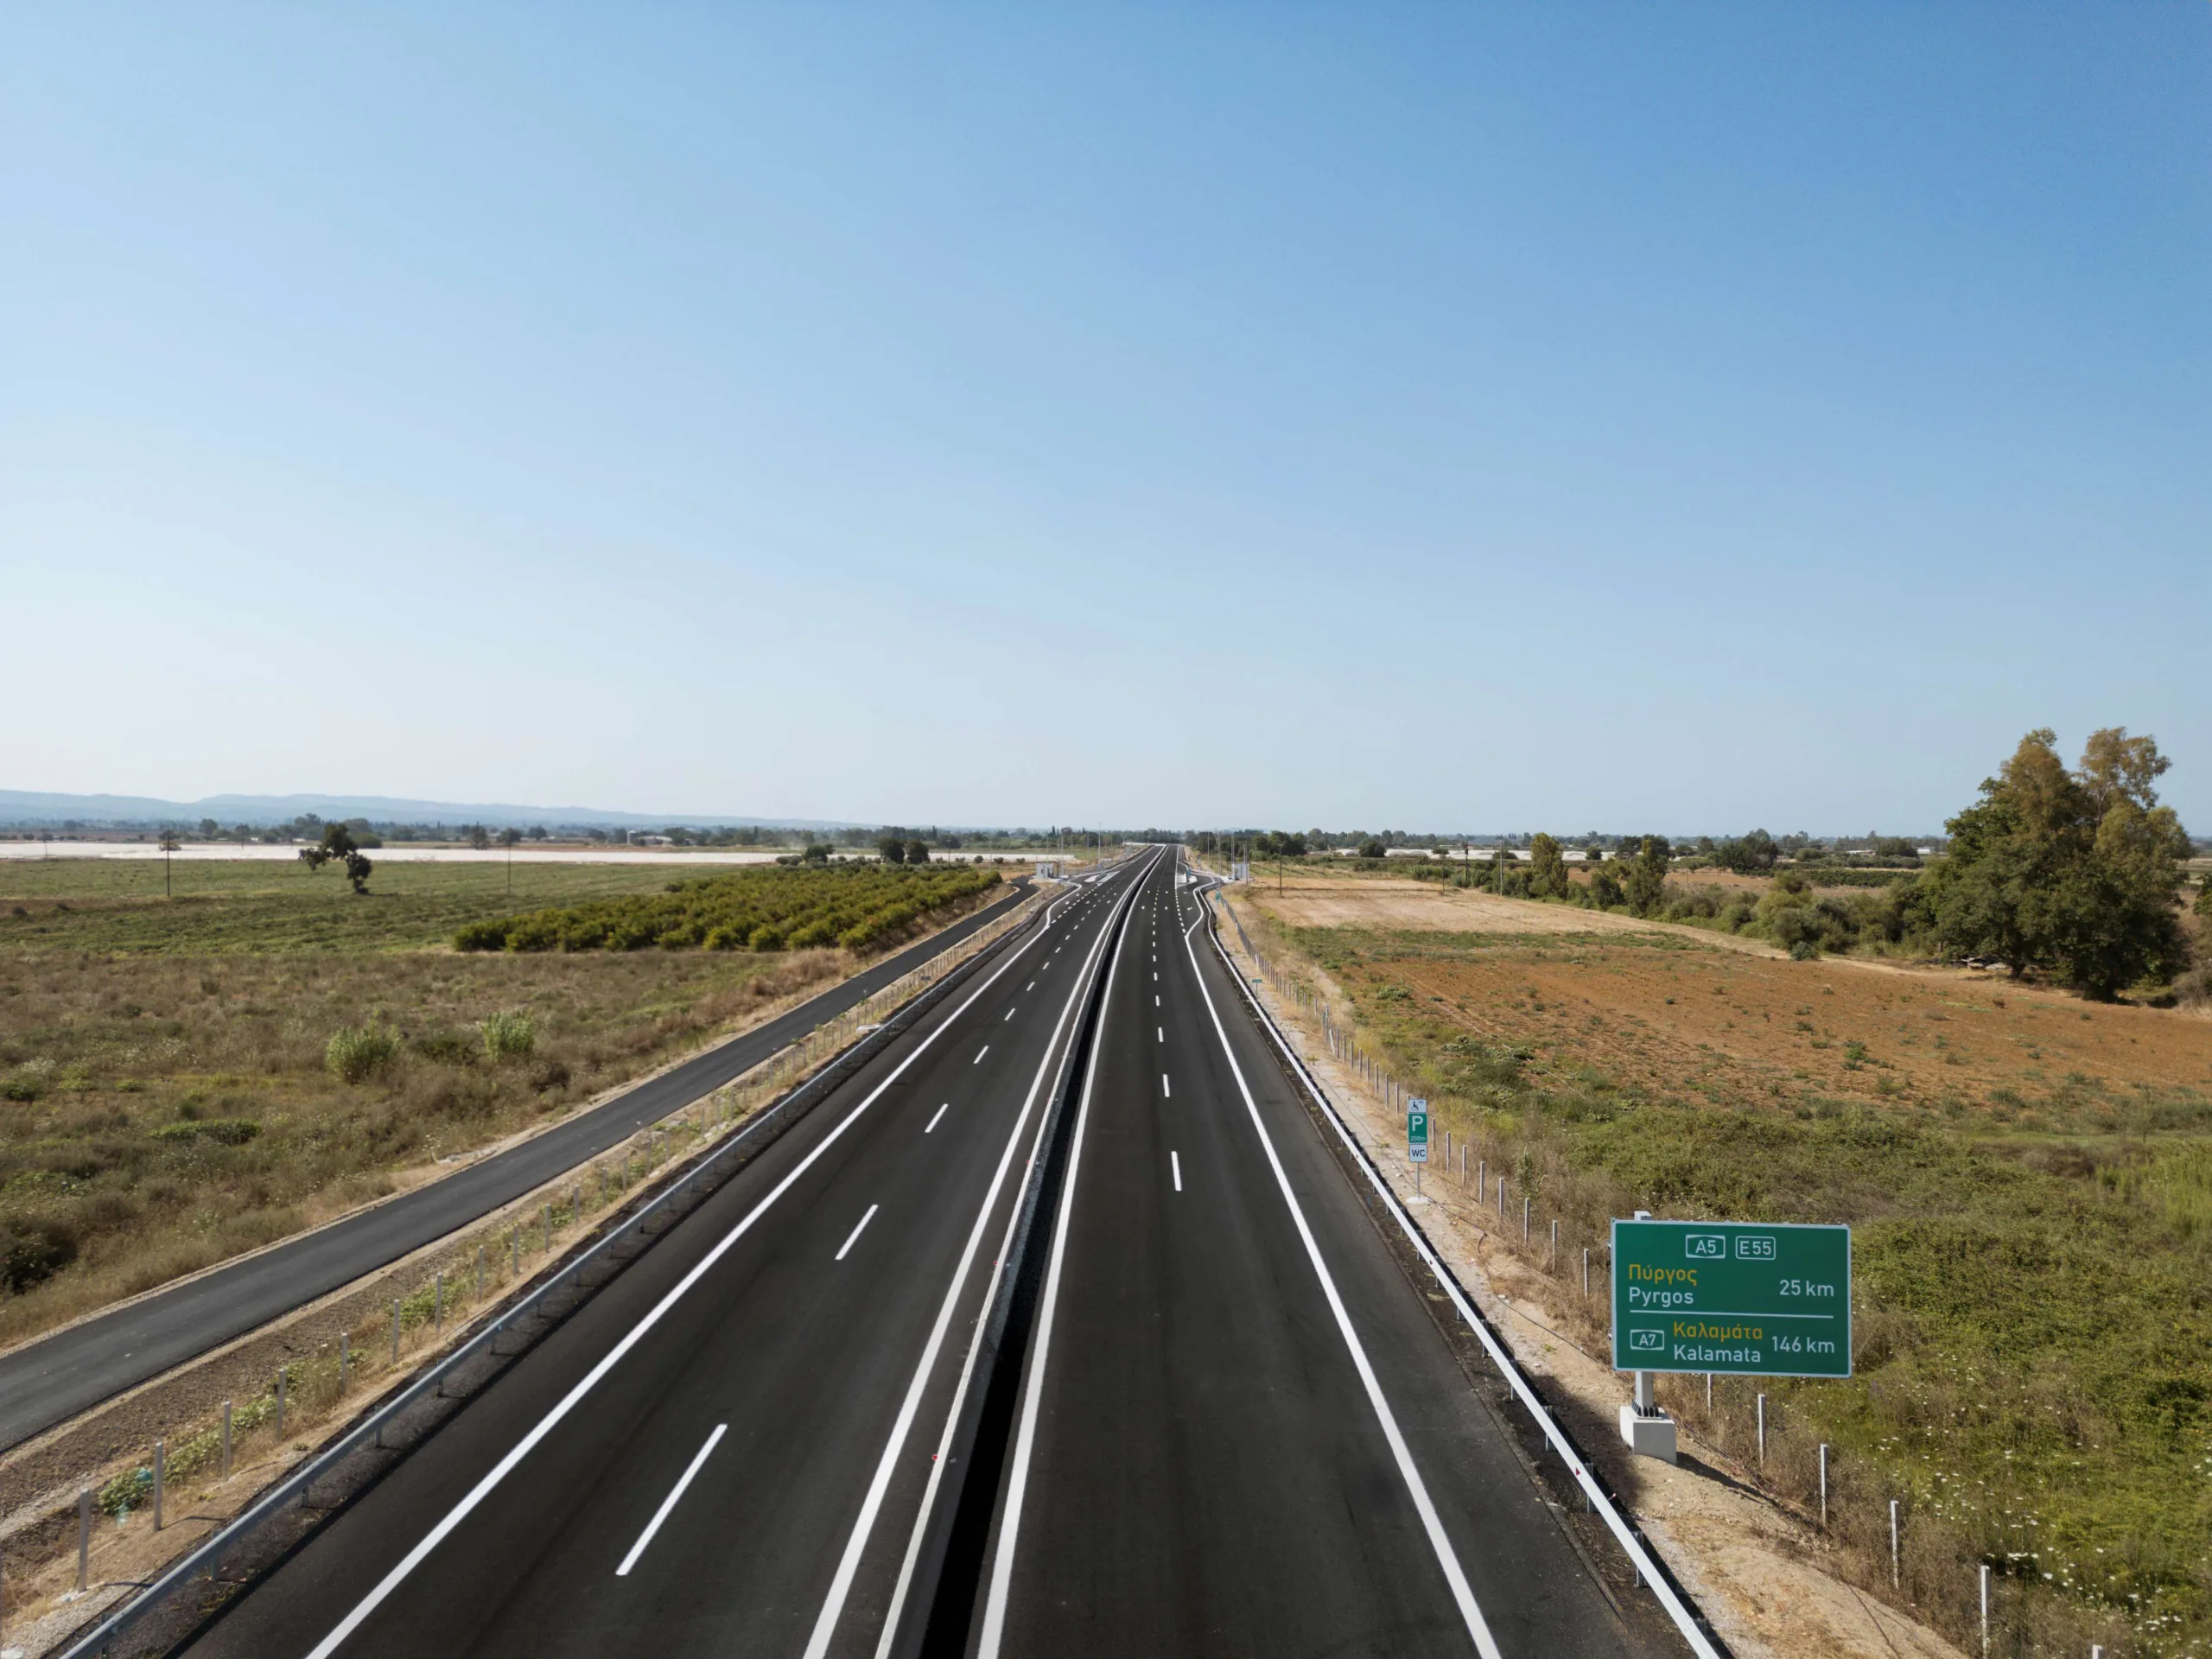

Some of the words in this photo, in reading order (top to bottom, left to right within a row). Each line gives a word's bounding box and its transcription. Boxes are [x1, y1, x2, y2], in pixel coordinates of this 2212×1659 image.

[1412, 1116, 1424, 1132] P
[1695, 1240, 1717, 1254] A5
[1629, 1264, 1697, 1286] Πύργος
[1630, 1287, 1694, 1307] Pyrgos
[1779, 1280, 1801, 1296] 25
[1806, 1281, 1834, 1297] km
[1638, 1334, 1656, 1346] A7
[1673, 1322, 1763, 1342] Καλαμάτα
[1772, 1336, 1802, 1352] 146
[1807, 1337, 1835, 1353] km
[1674, 1344, 1761, 1363] Kalamata
